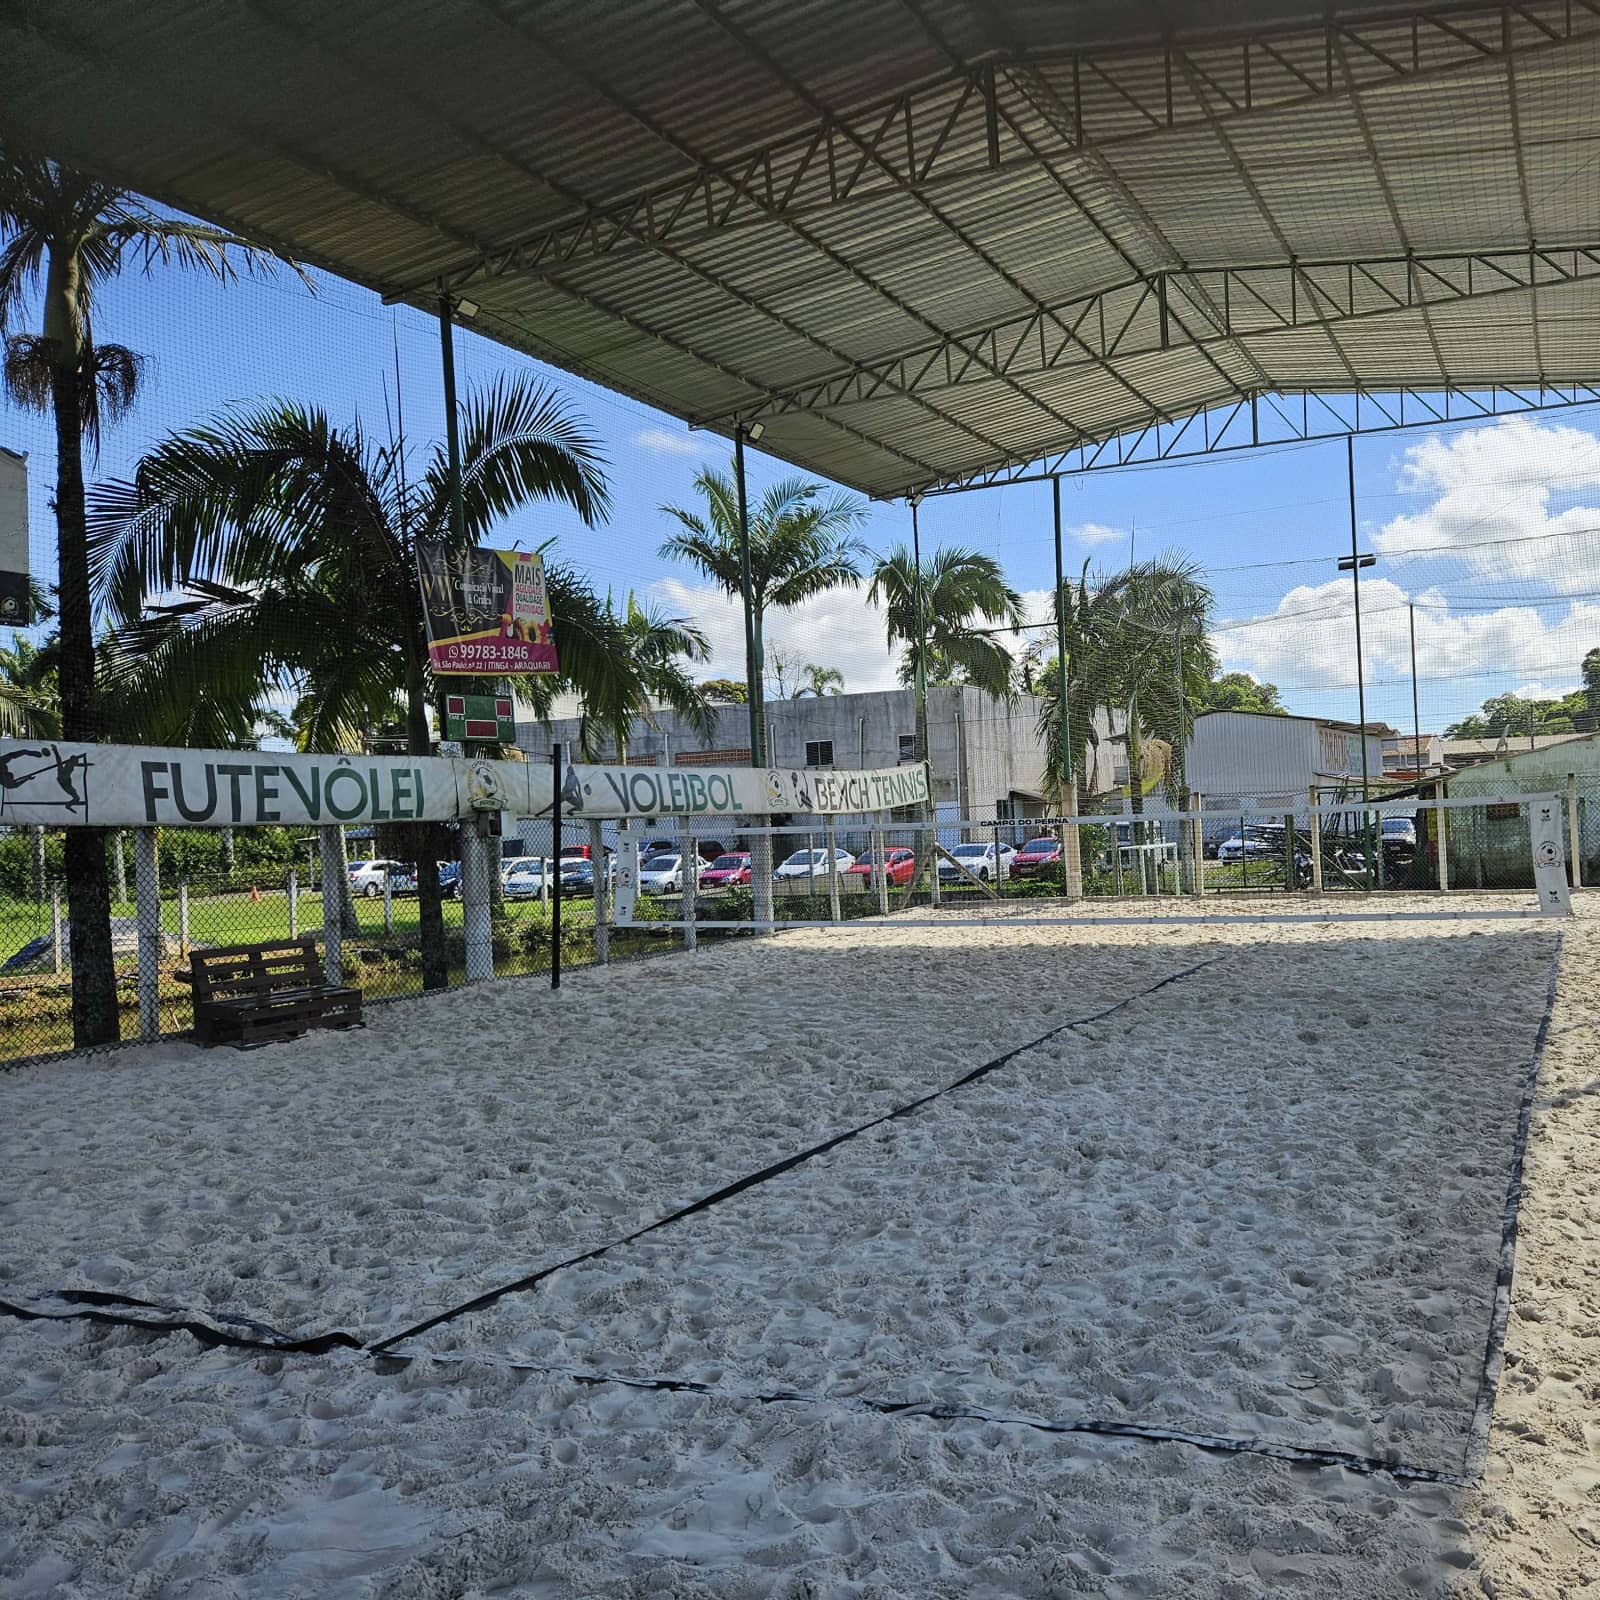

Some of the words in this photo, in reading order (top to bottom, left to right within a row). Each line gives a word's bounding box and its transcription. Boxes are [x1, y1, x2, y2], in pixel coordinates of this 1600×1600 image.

[514, 564, 541, 586] MAIS
[460, 645, 528, 659] 99783-1846
[140, 758, 424, 823] FUTEVÔLEI
[604, 772, 742, 812] VOLEIBOL
[815, 773, 871, 811] BEACH
[872, 769, 926, 805] TENNIS
